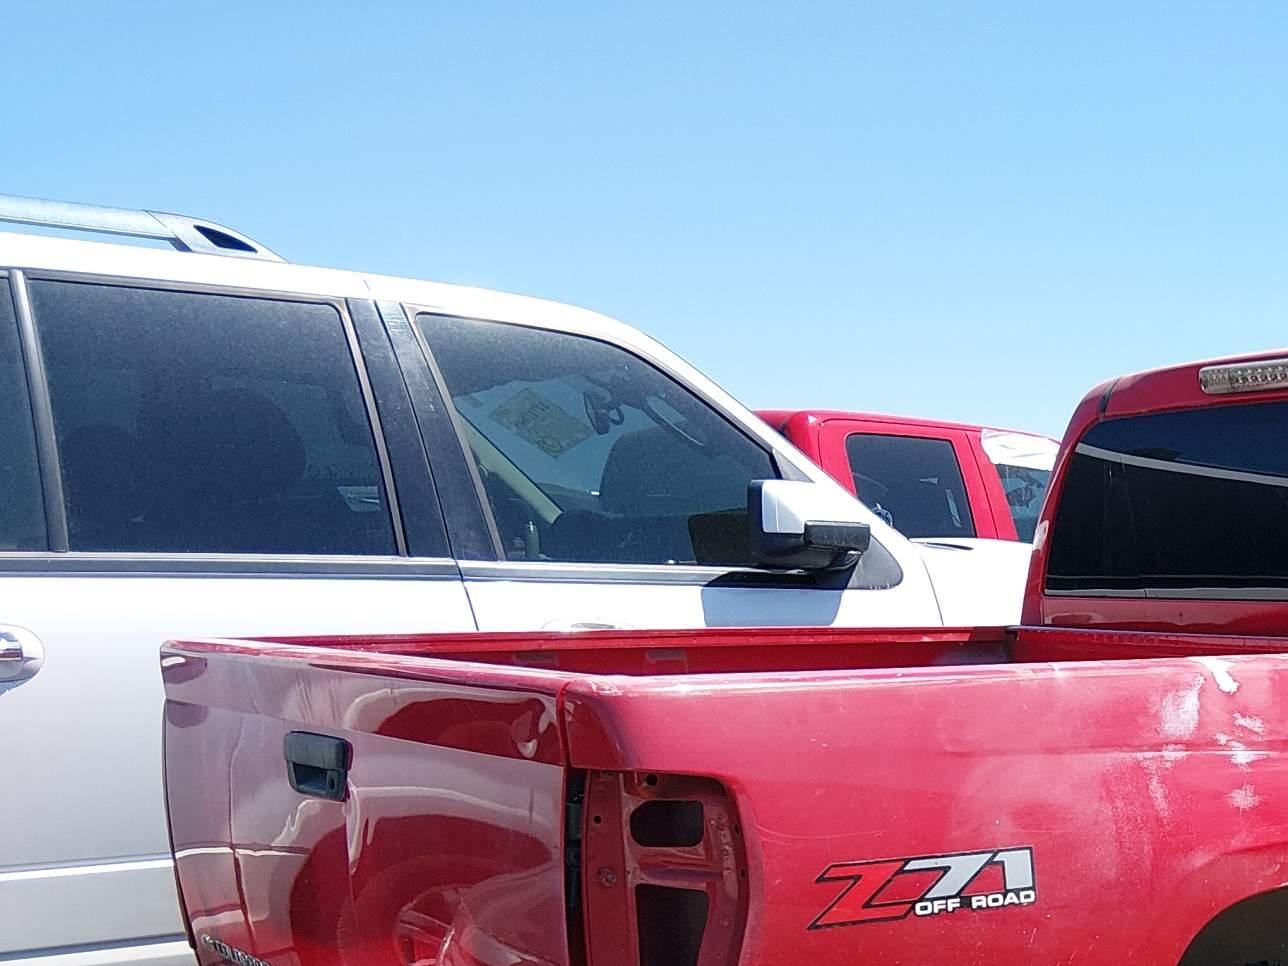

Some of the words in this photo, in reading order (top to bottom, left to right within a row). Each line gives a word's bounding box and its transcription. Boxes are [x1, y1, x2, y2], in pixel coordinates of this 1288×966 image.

[806, 846, 1036, 929] Z71
[914, 898, 961, 916] OFF
[970, 889, 1036, 909] ROAD
